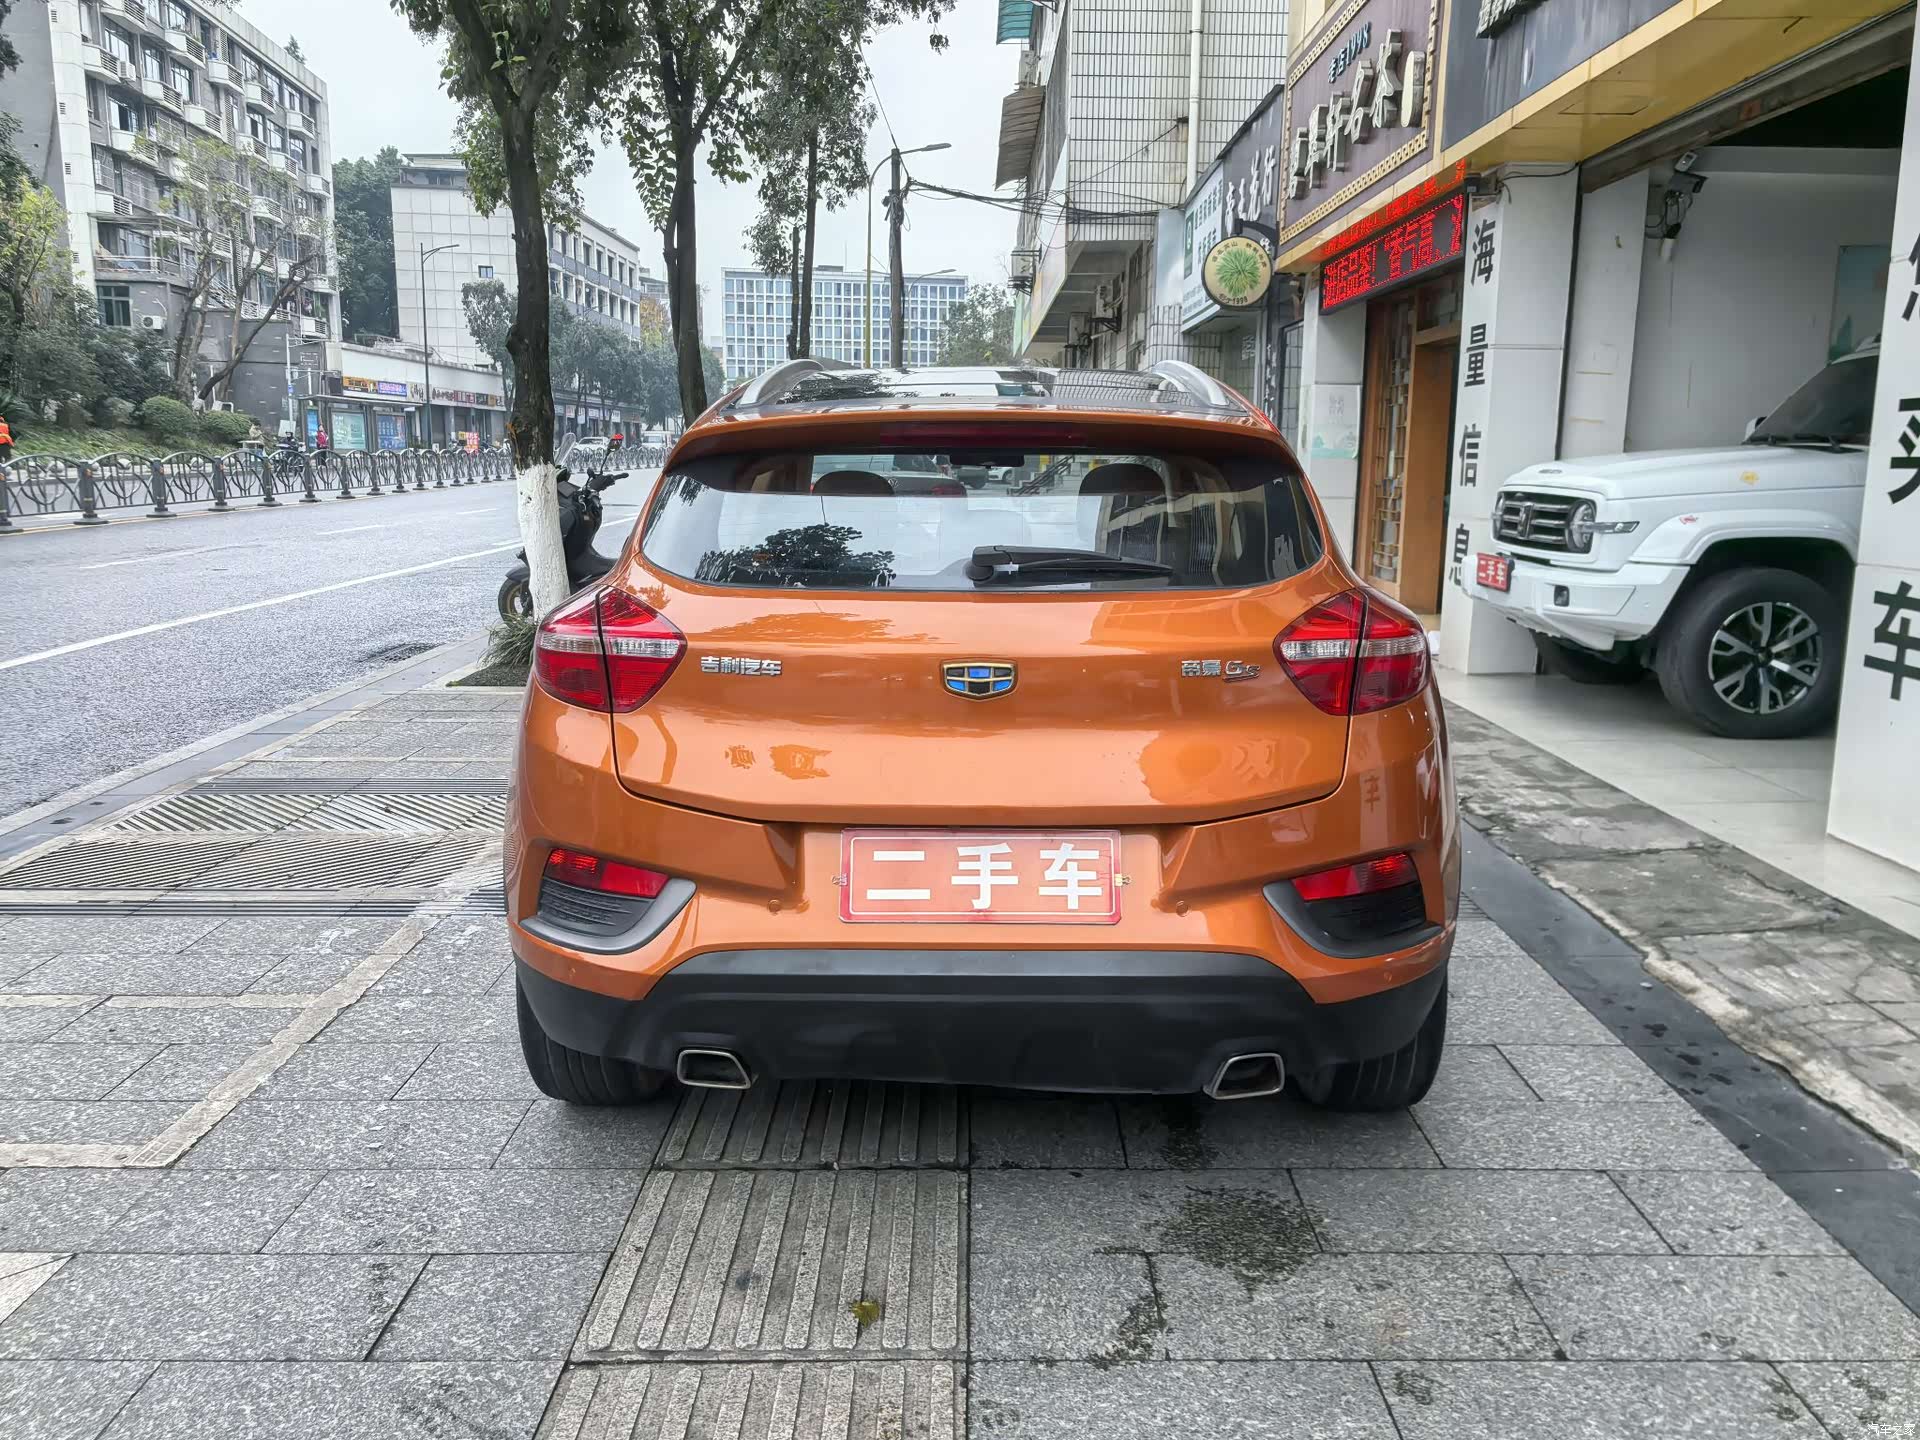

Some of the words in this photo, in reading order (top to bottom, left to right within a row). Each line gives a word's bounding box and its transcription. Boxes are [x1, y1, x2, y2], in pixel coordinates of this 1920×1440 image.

[1449, 219, 1496, 586] 海量信息
[1478, 560, 1506, 585] 二手车
[701, 656, 782, 676] 吉利汽车
[1181, 660, 1221, 677] 帝豪
[866, 842, 1102, 910] 二手车
